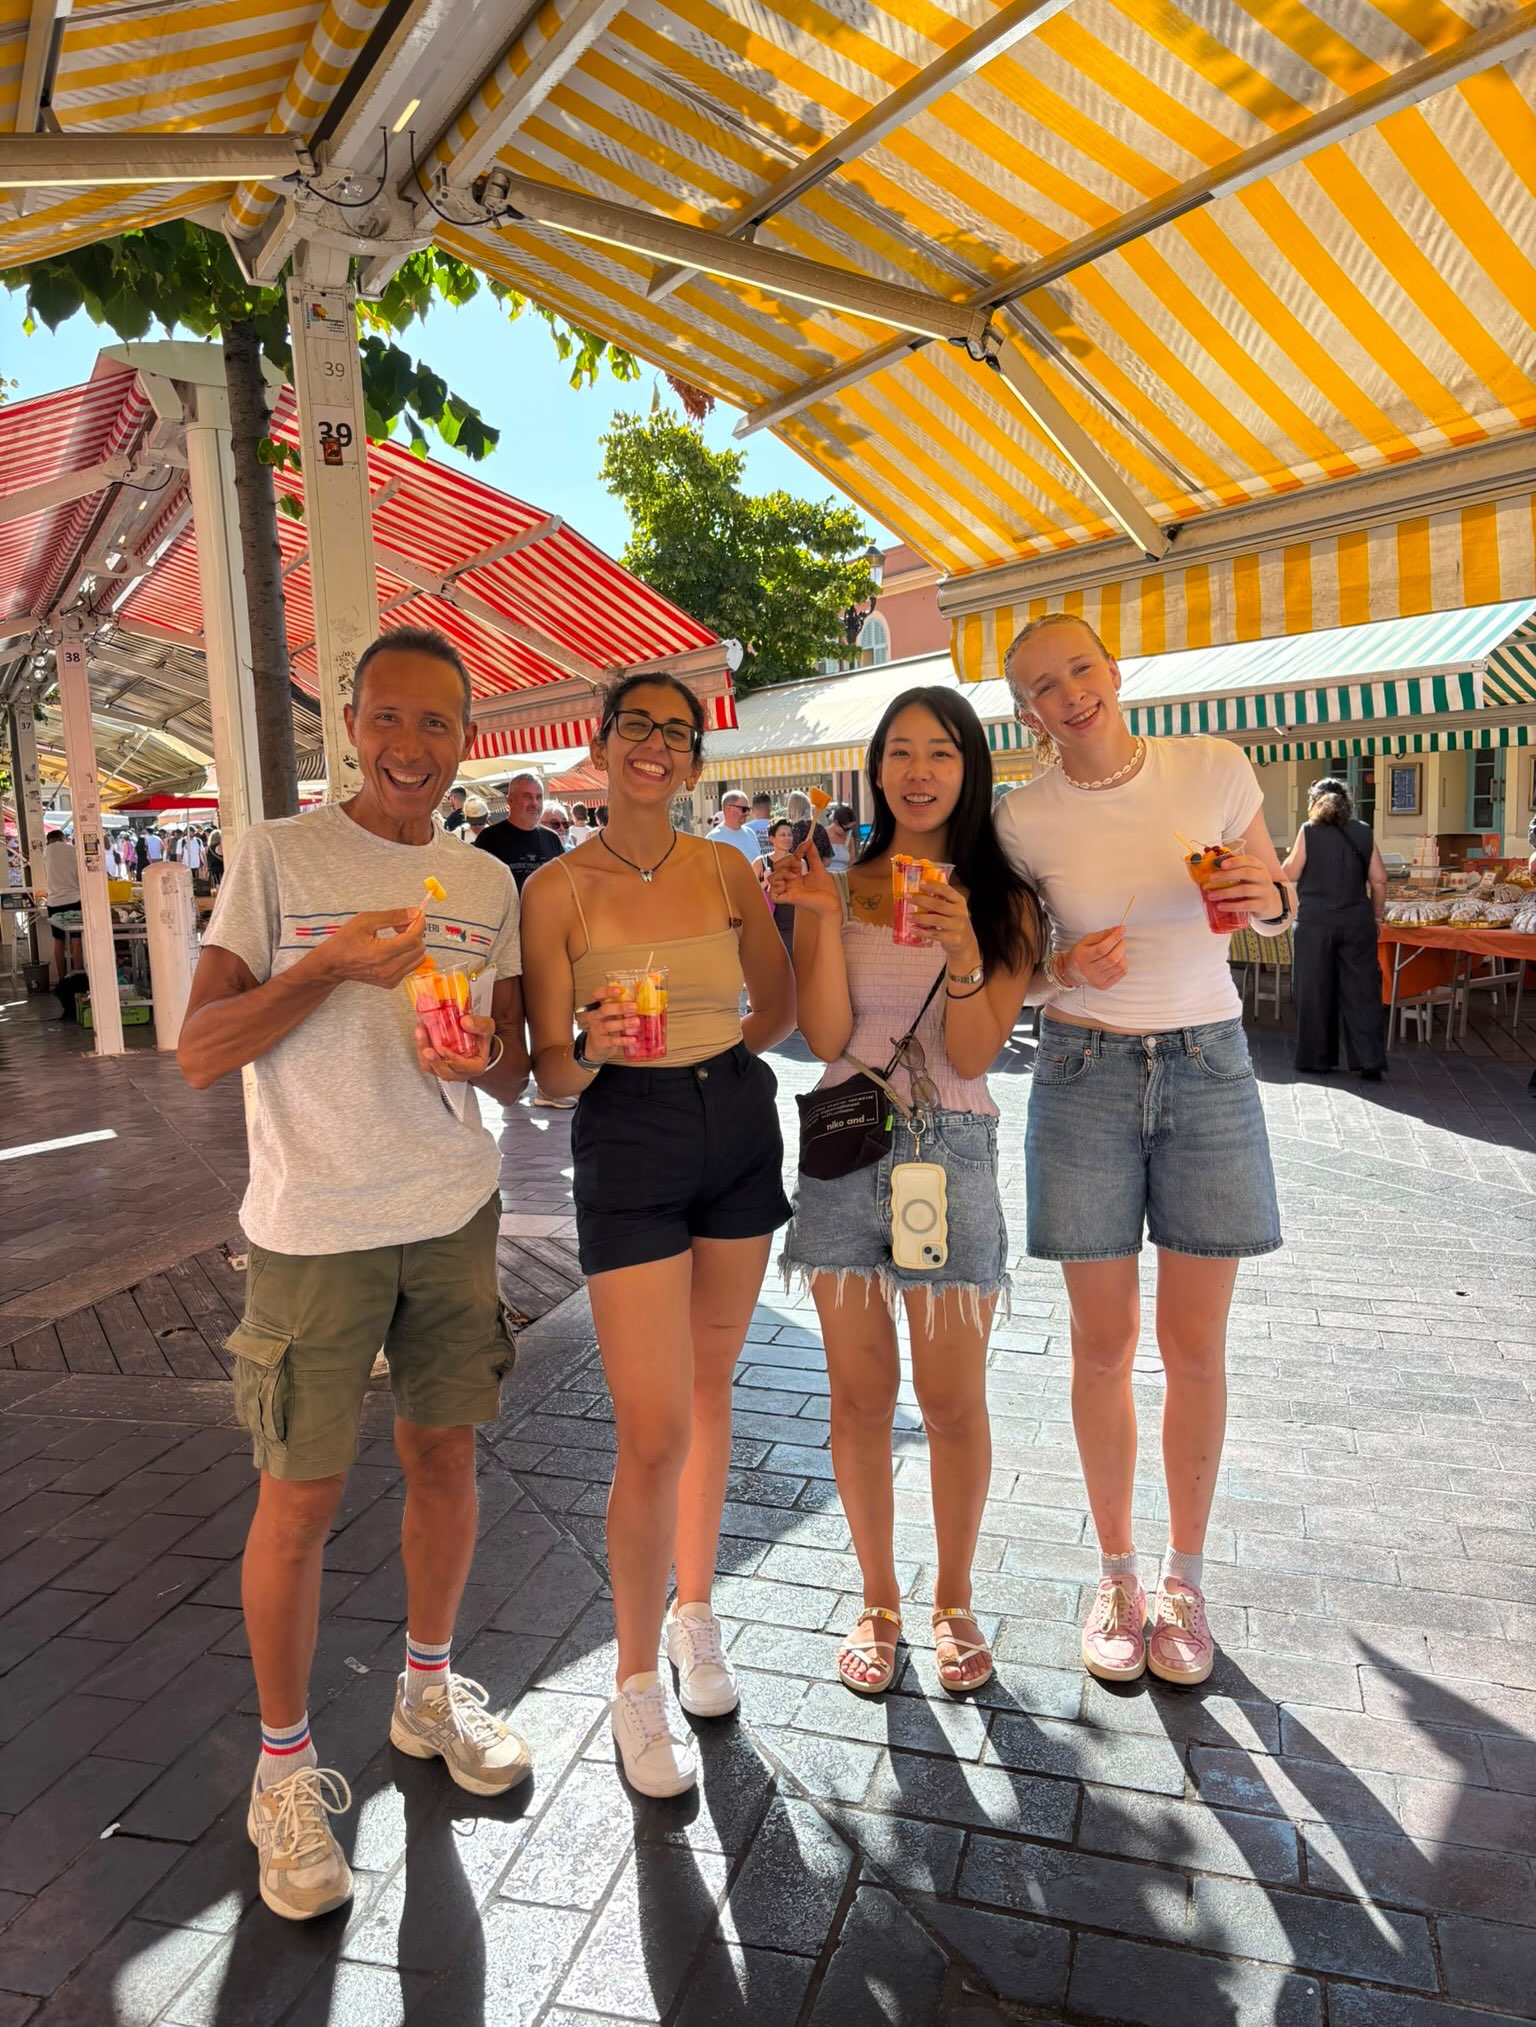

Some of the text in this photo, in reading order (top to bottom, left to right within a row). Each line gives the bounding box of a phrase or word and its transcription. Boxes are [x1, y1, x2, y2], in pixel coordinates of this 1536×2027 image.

[324, 361, 345, 378] 39
[318, 421, 352, 448] 39
[65, 652, 81, 663] 38
[21, 722, 31, 730] 37
[826, 1120, 845, 1131] niko
[846, 1114, 865, 1125] and
